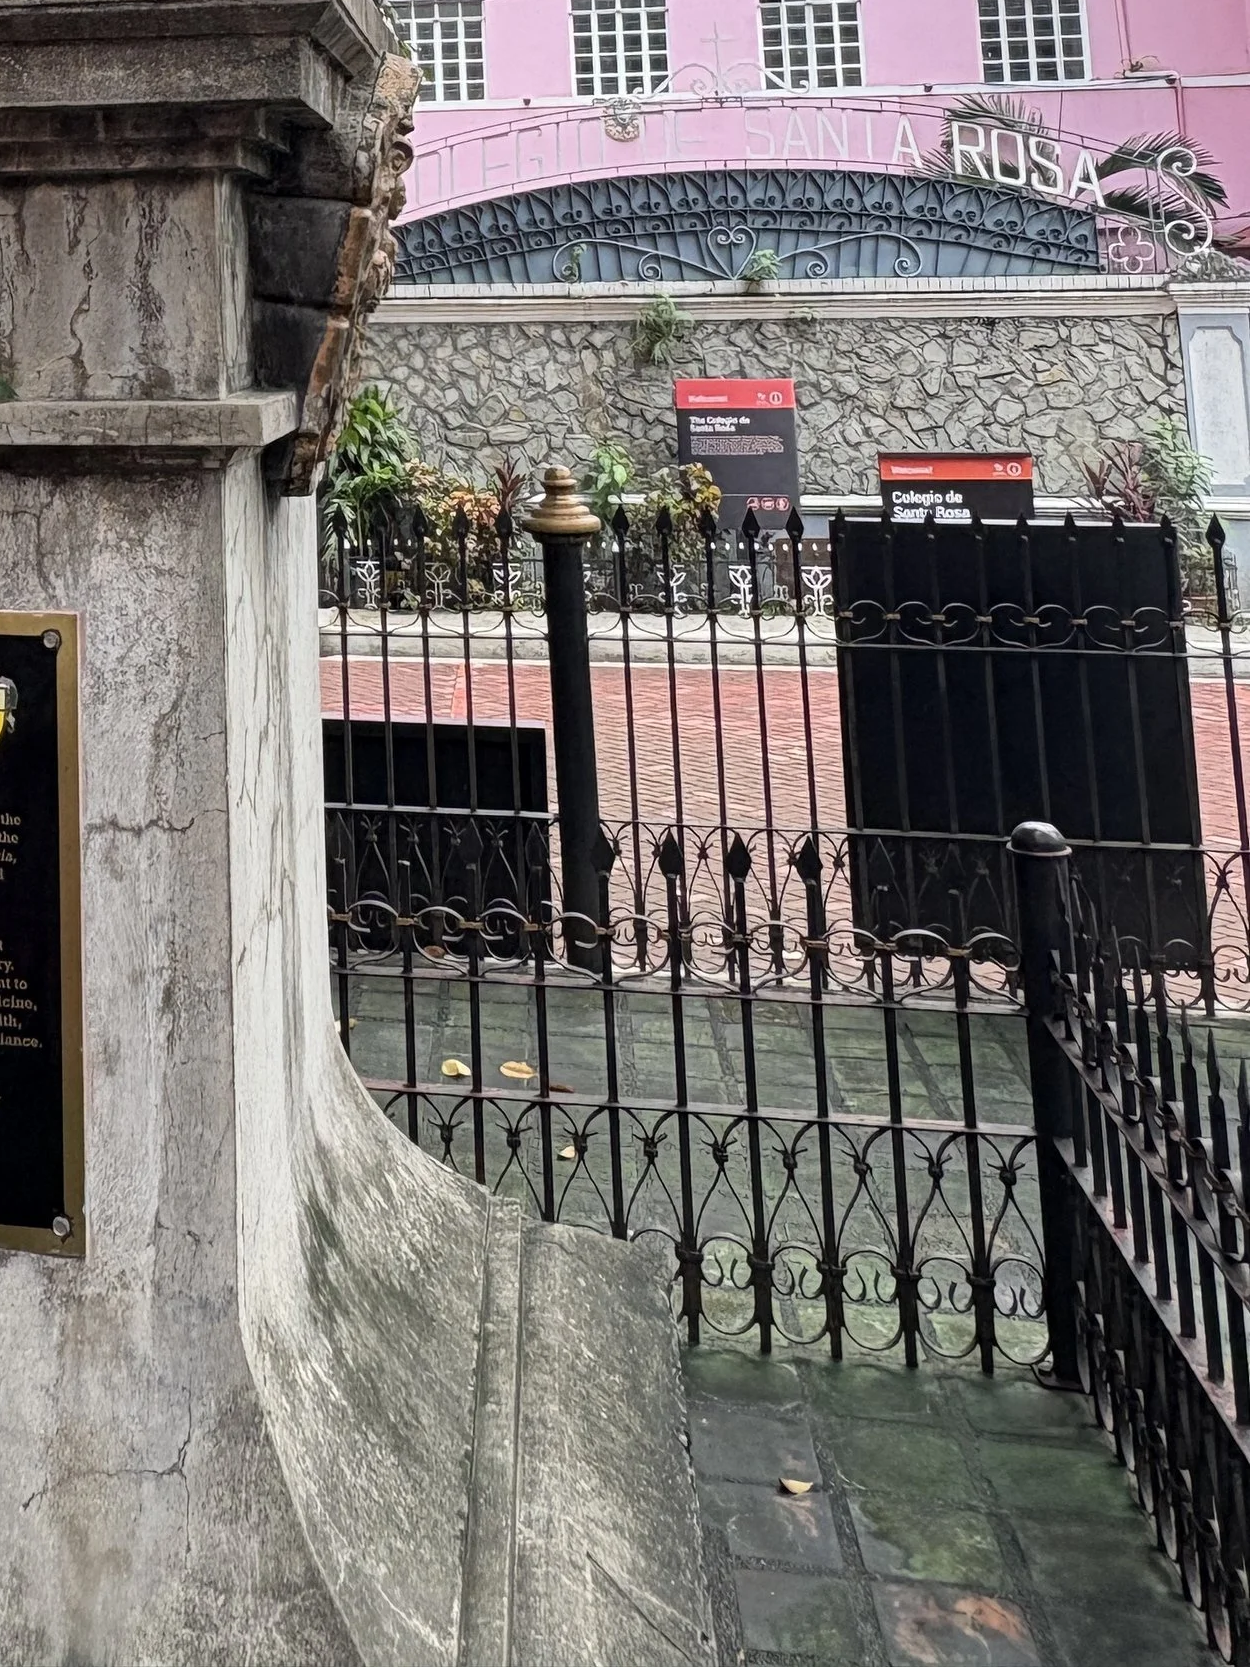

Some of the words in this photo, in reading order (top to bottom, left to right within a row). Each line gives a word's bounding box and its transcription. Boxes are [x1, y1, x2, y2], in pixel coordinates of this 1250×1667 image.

[745, 108, 924, 169] SANTA
[951, 120, 1107, 209] ROSA
[892, 490, 943, 506] Colegio
[945, 490, 963, 504] de
[935, 506, 971, 519] Rosa
